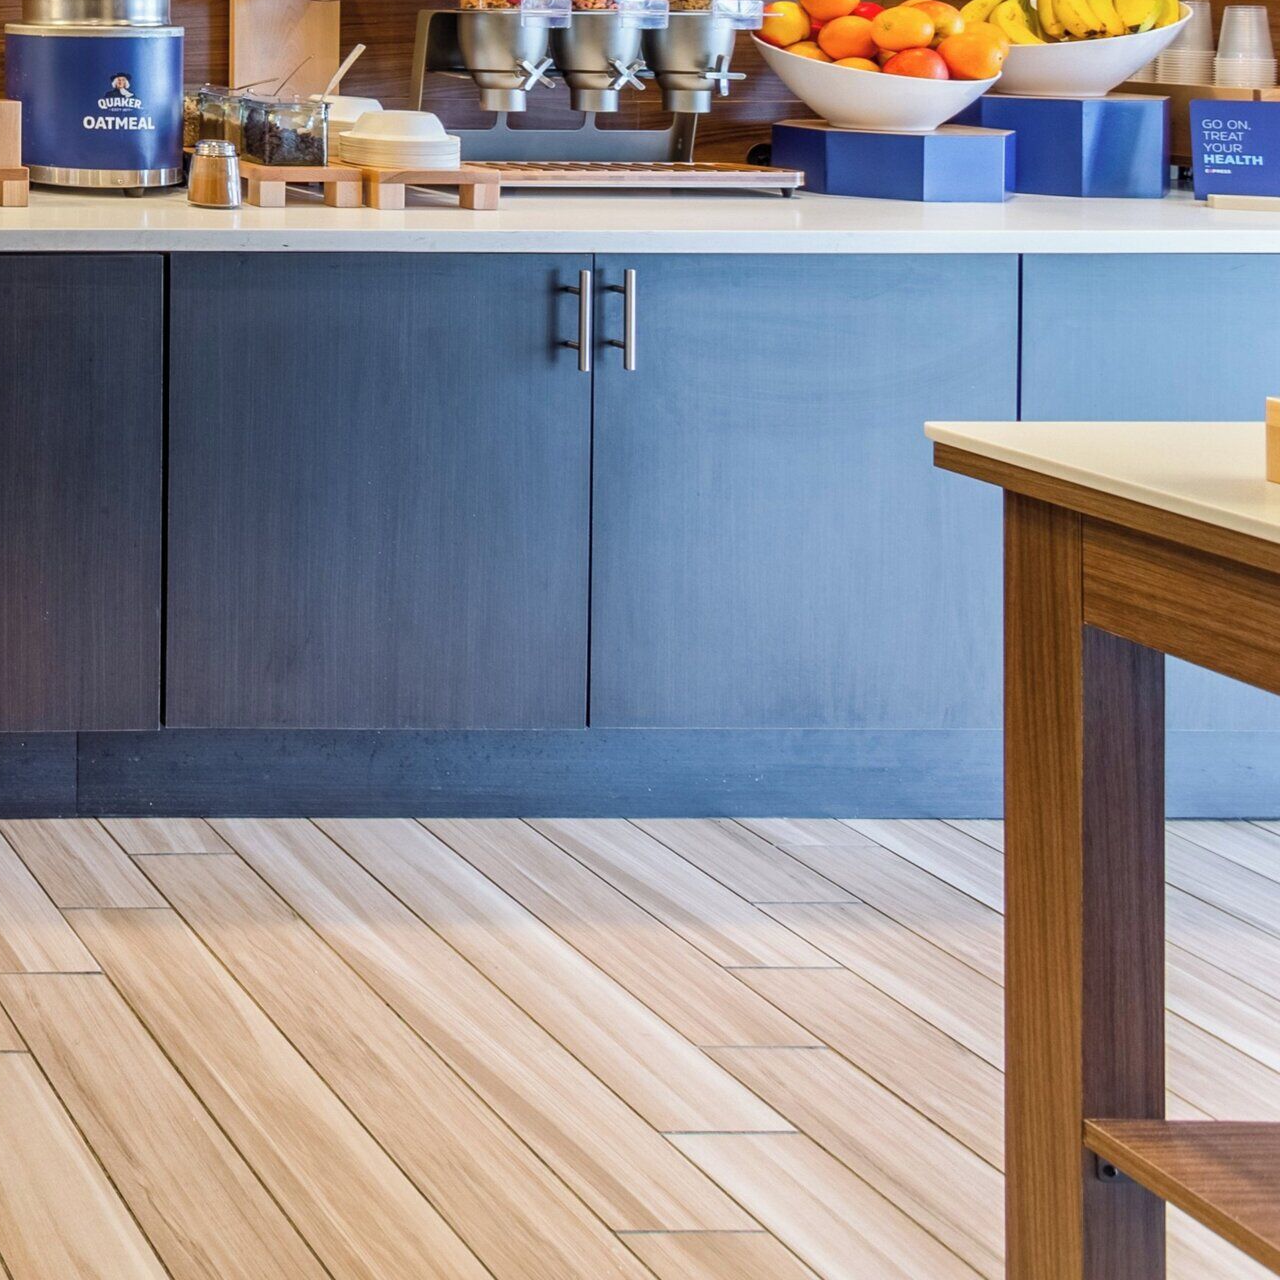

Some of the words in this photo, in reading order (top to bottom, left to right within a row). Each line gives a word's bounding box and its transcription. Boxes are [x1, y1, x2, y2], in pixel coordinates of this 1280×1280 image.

[97, 97, 142, 110] QUAKER
[82, 116, 155, 130] OATMEAL
[1202, 119, 1222, 129] GO
[1227, 120, 1251, 130] ON.
[1203, 131, 1244, 141] TREAT
[1203, 143, 1242, 153] YOUR
[1203, 154, 1263, 165] HEALTH
